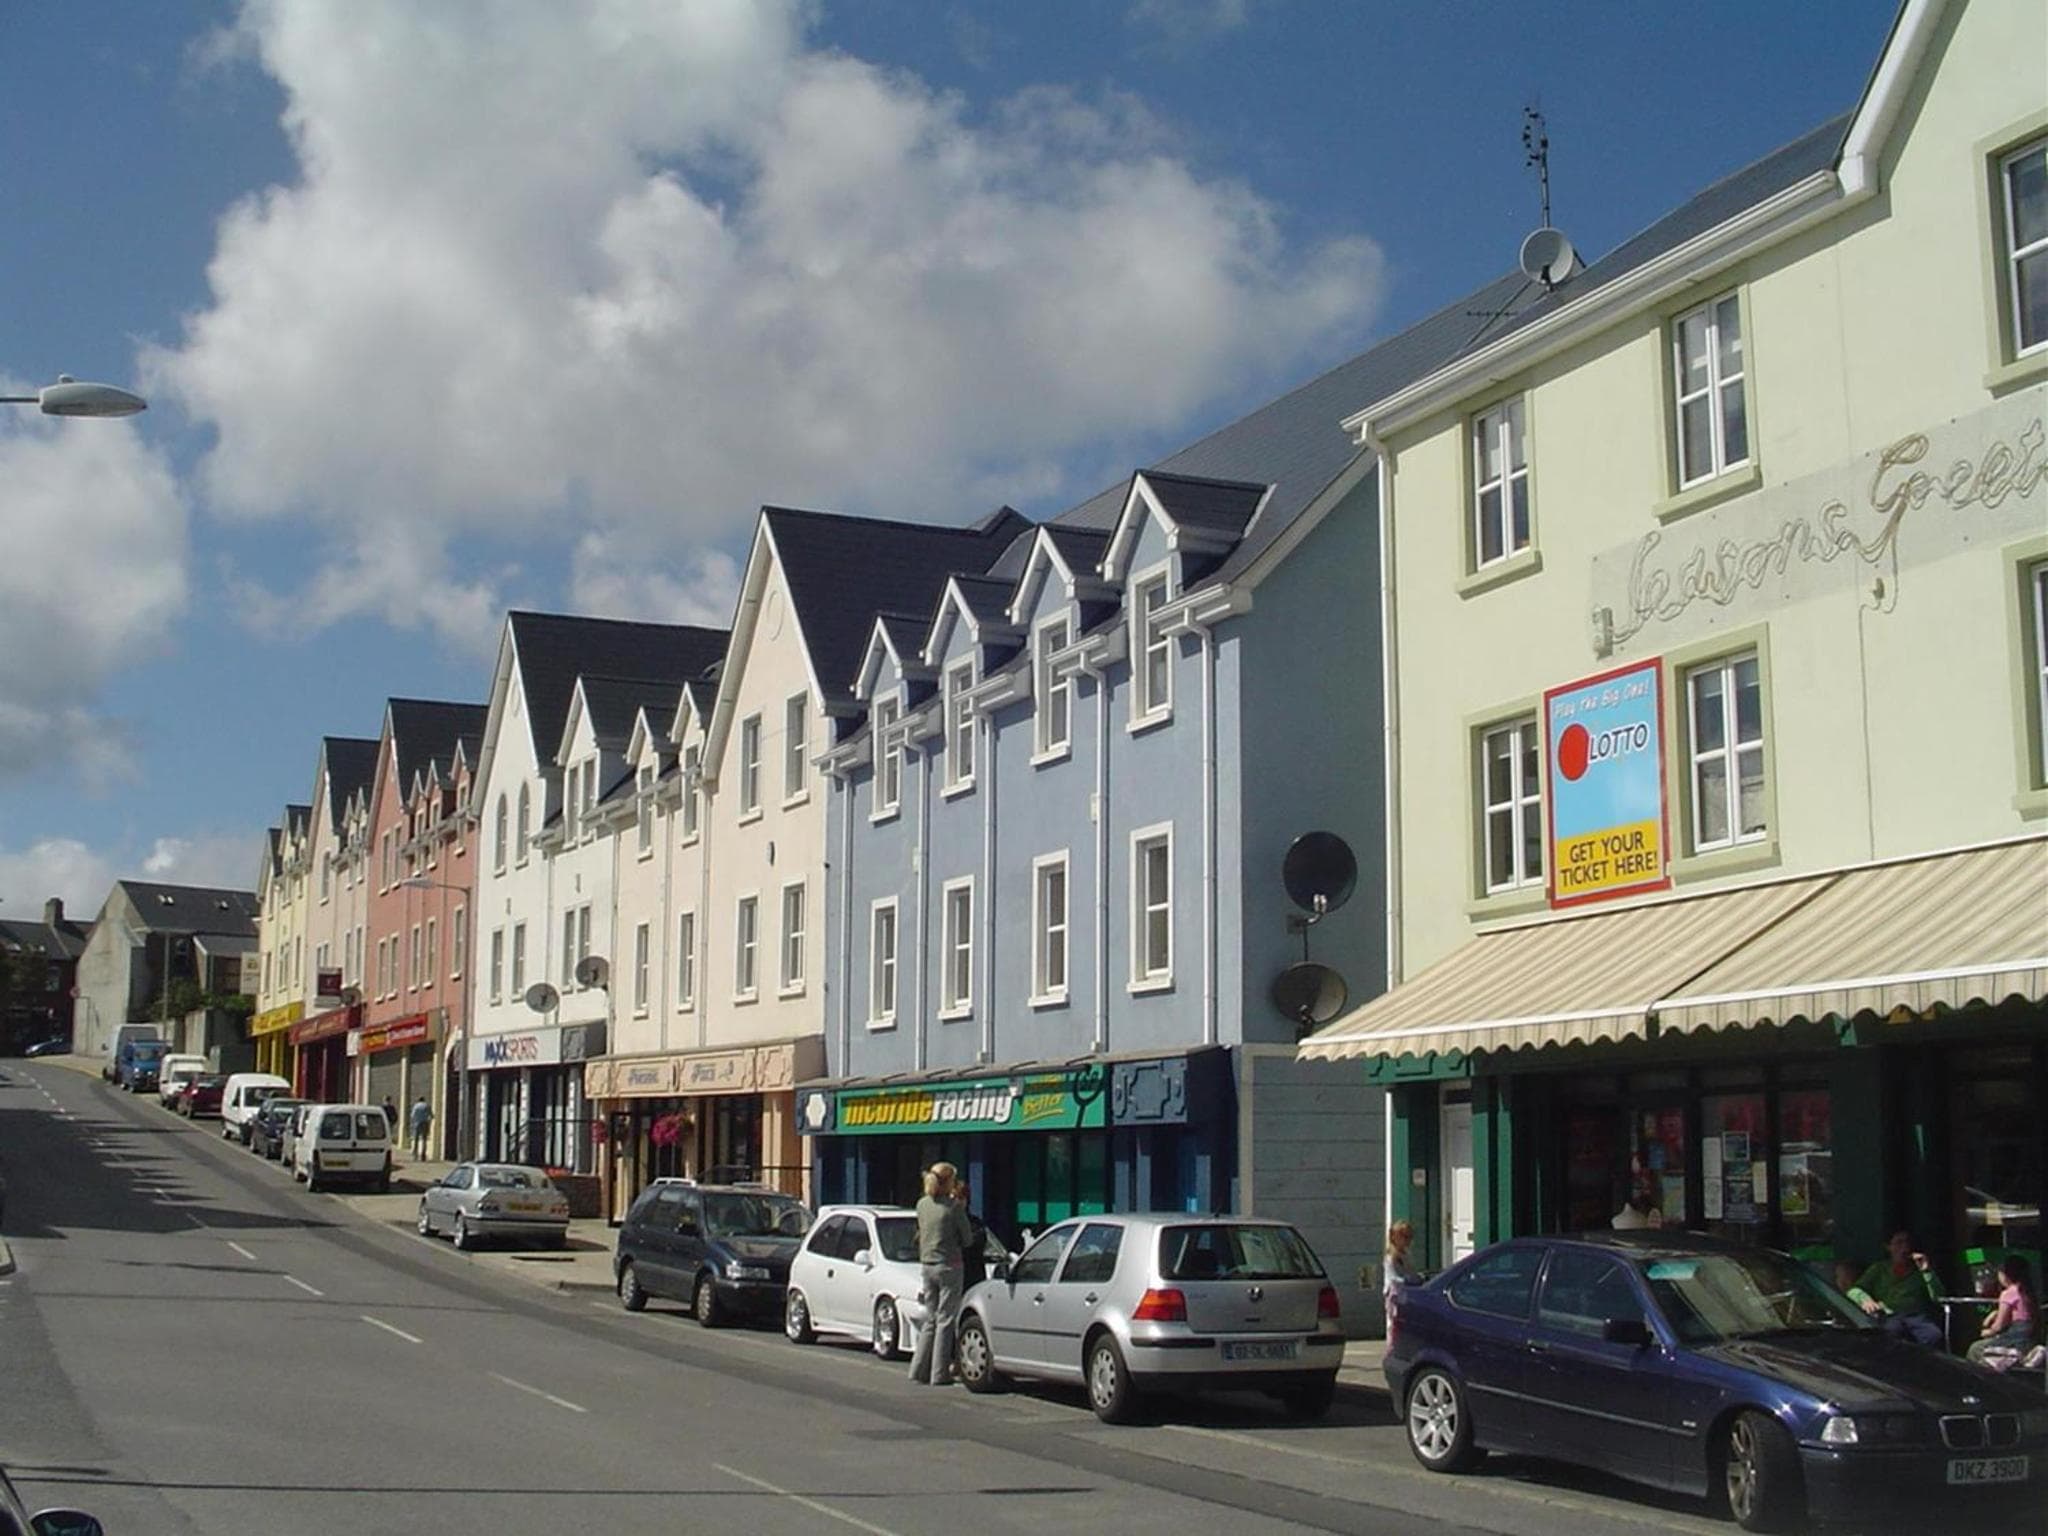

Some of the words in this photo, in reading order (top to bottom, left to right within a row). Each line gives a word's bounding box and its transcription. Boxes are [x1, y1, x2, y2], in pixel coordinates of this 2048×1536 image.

[1868, 417, 2048, 535] Greet
[1589, 723, 1649, 761] LOTTO
[1569, 841, 1596, 863] GET
[1601, 831, 1645, 857] YOUR
[1561, 860, 1609, 887] TICKET
[1615, 850, 1658, 877] HERE!
